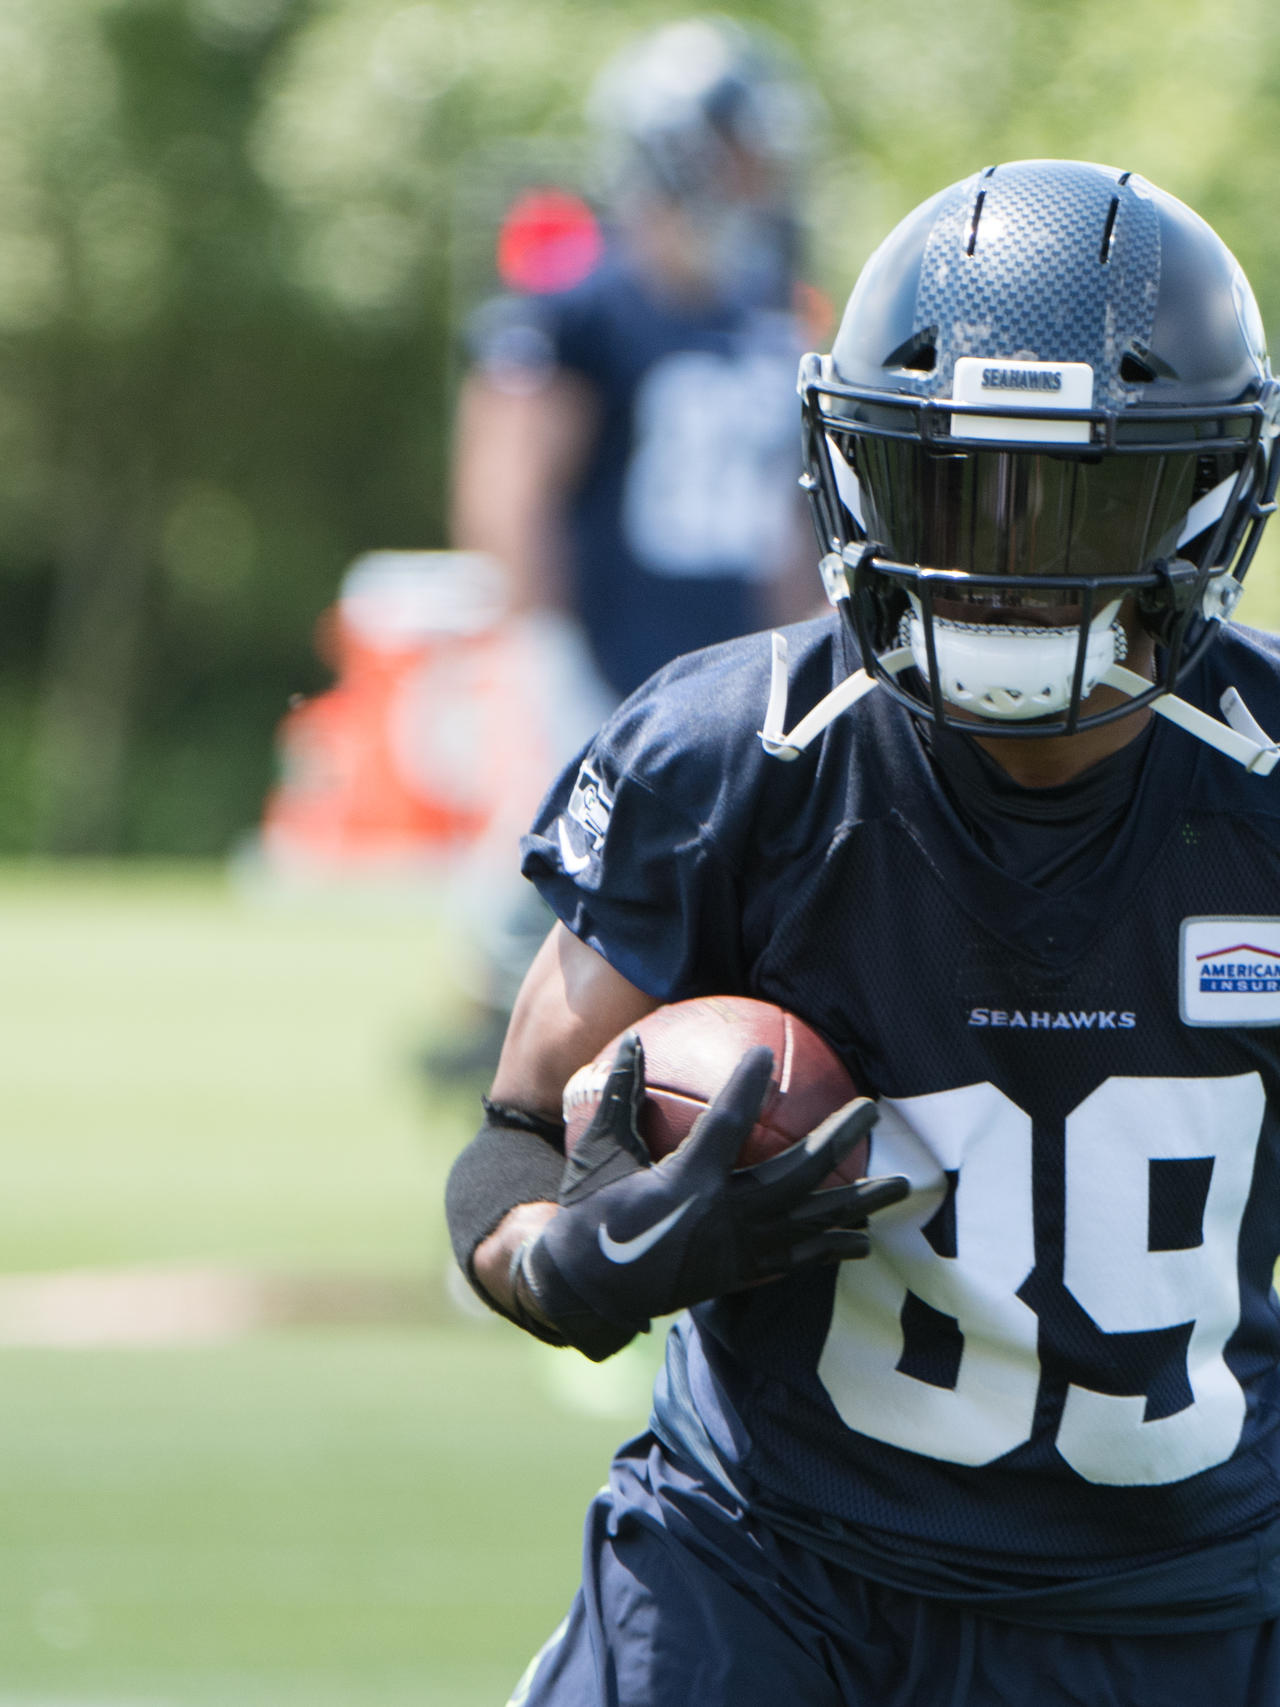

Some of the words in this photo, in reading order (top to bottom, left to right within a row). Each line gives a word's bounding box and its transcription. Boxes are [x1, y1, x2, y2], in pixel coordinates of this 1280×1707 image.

[981, 367, 1062, 392] SEAHAWKS
[967, 1007, 1137, 1030] SEAHAWKS
[816, 1070, 1267, 1486] 89
